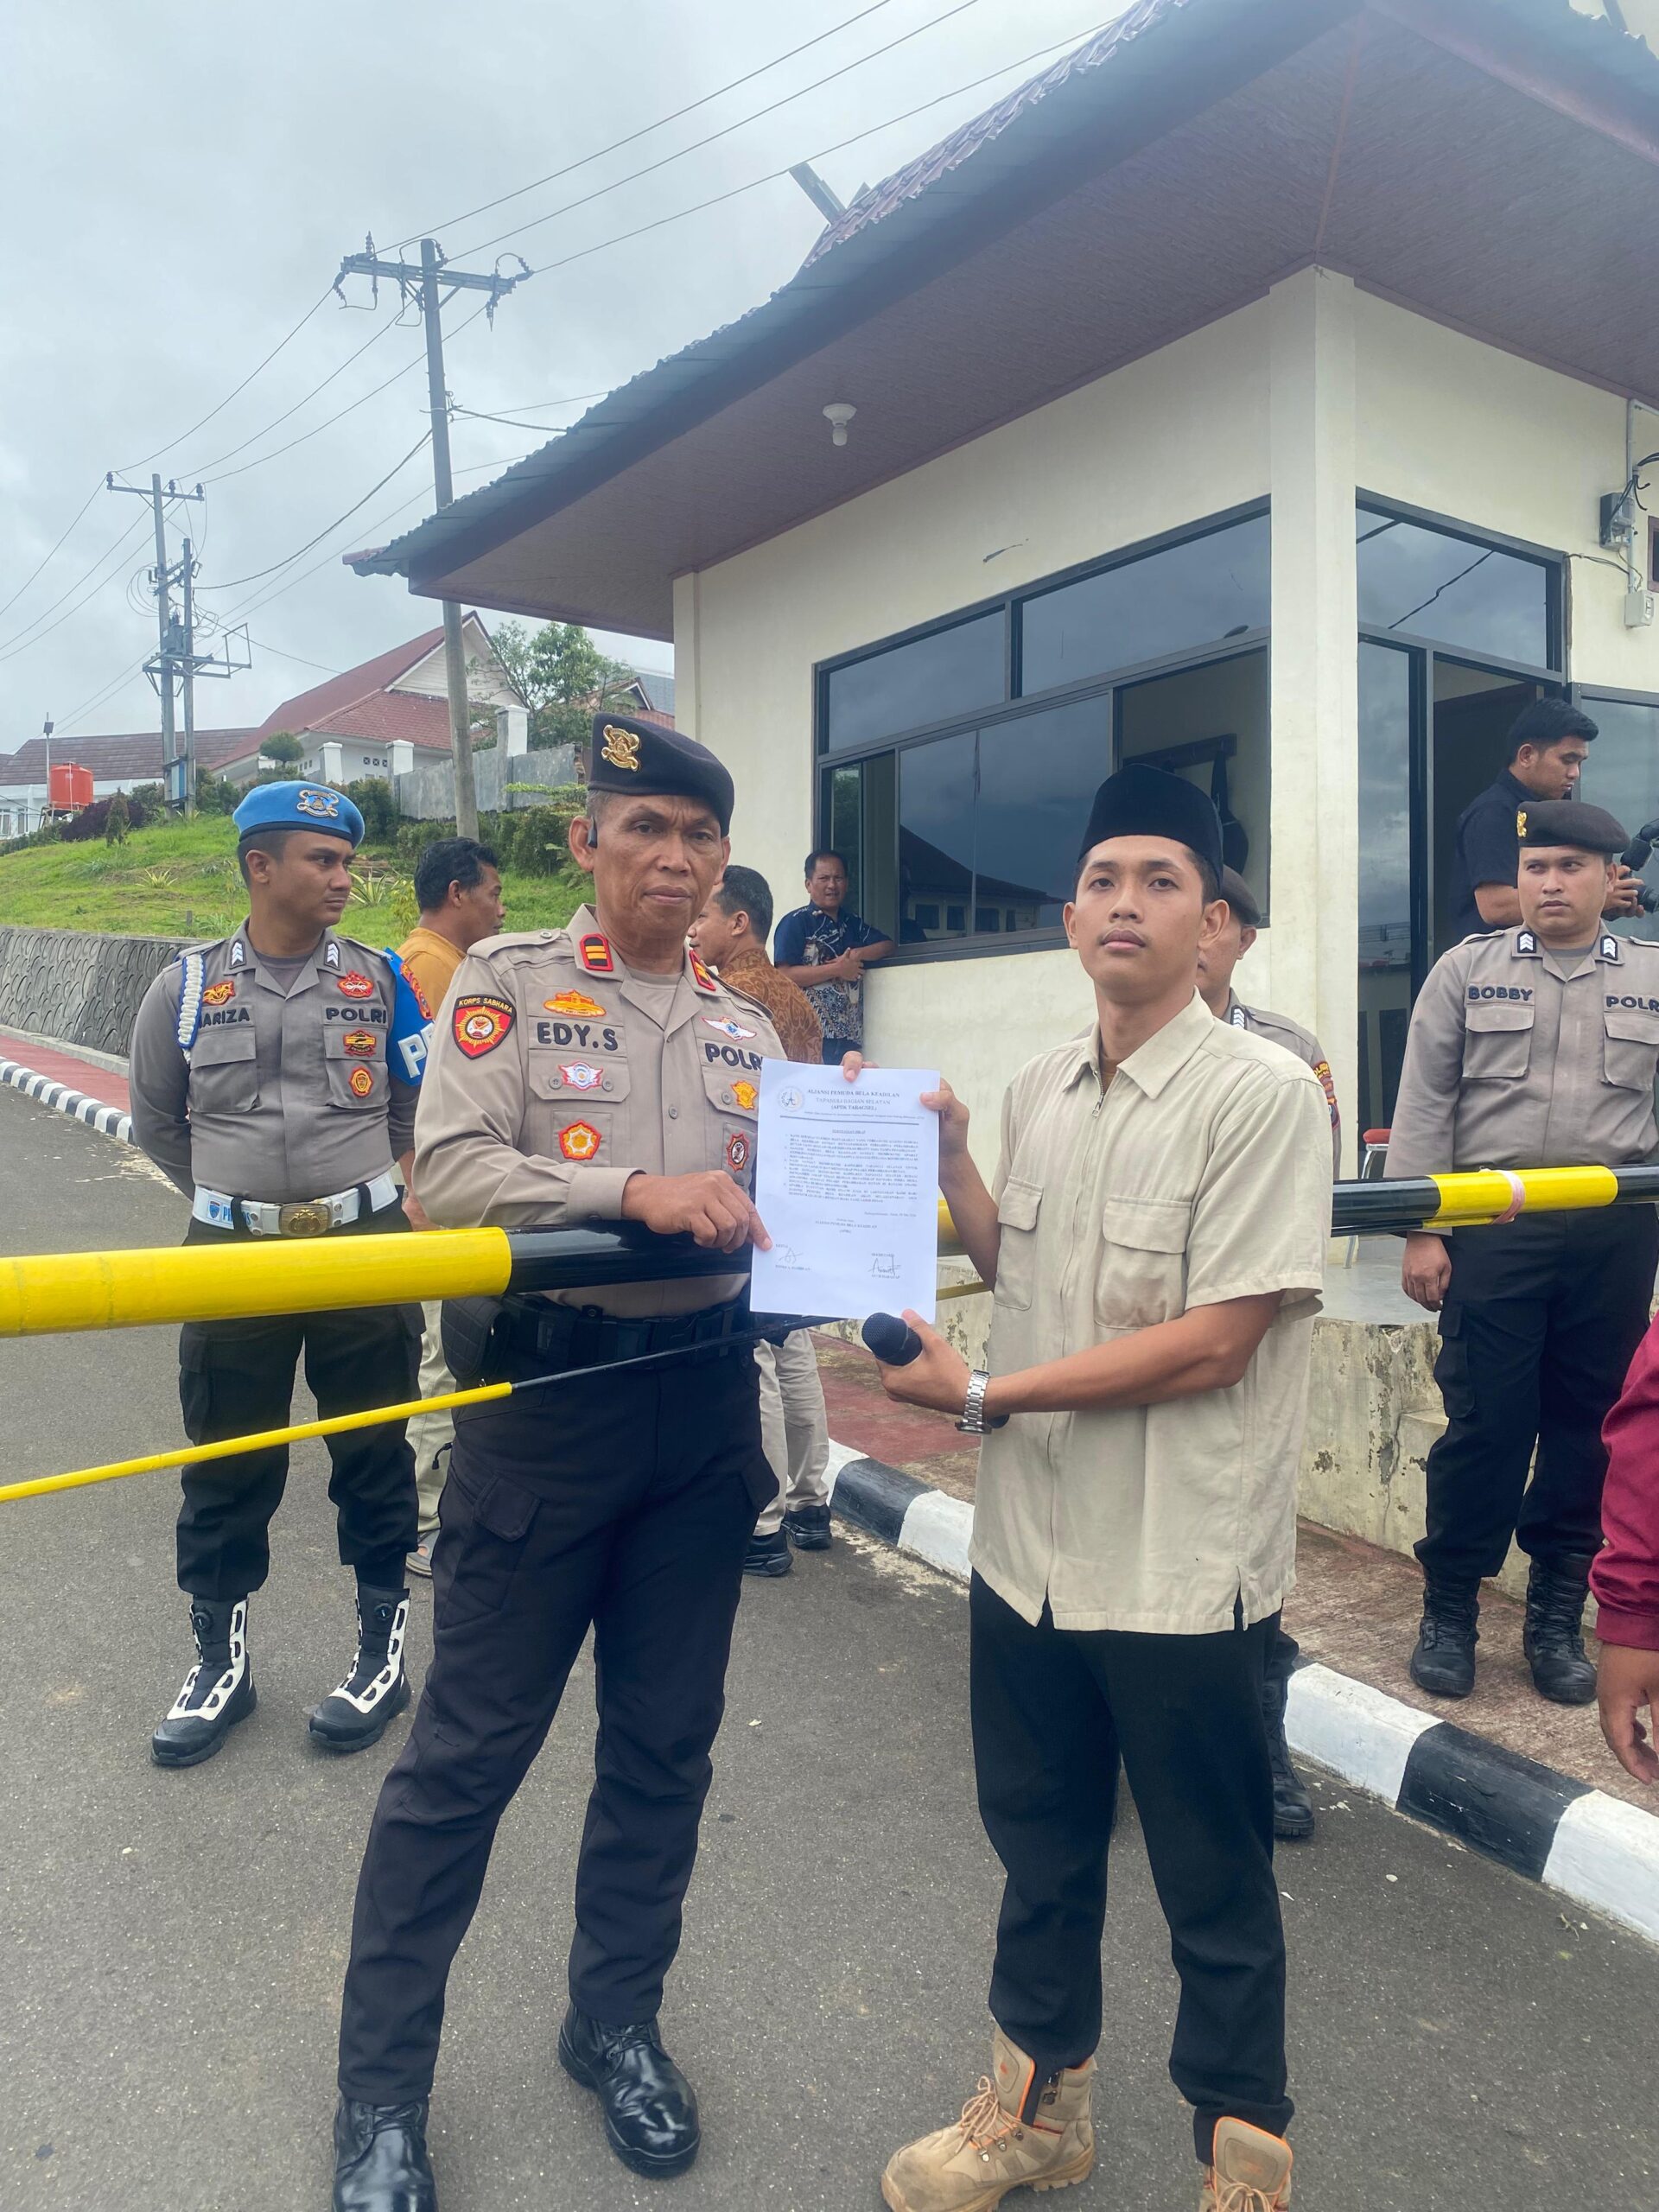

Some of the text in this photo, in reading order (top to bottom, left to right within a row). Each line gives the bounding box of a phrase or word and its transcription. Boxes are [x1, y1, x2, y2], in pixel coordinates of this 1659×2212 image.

[1467, 985, 1534, 1001] BOBBY
[458, 996, 512, 1014] KORPS SABHARA
[200, 1007, 251, 1028] ARIZA
[326, 1007, 387, 1024] POLRI
[537, 1021, 619, 1052] EDY.S
[704, 1042, 763, 1071] POLR
